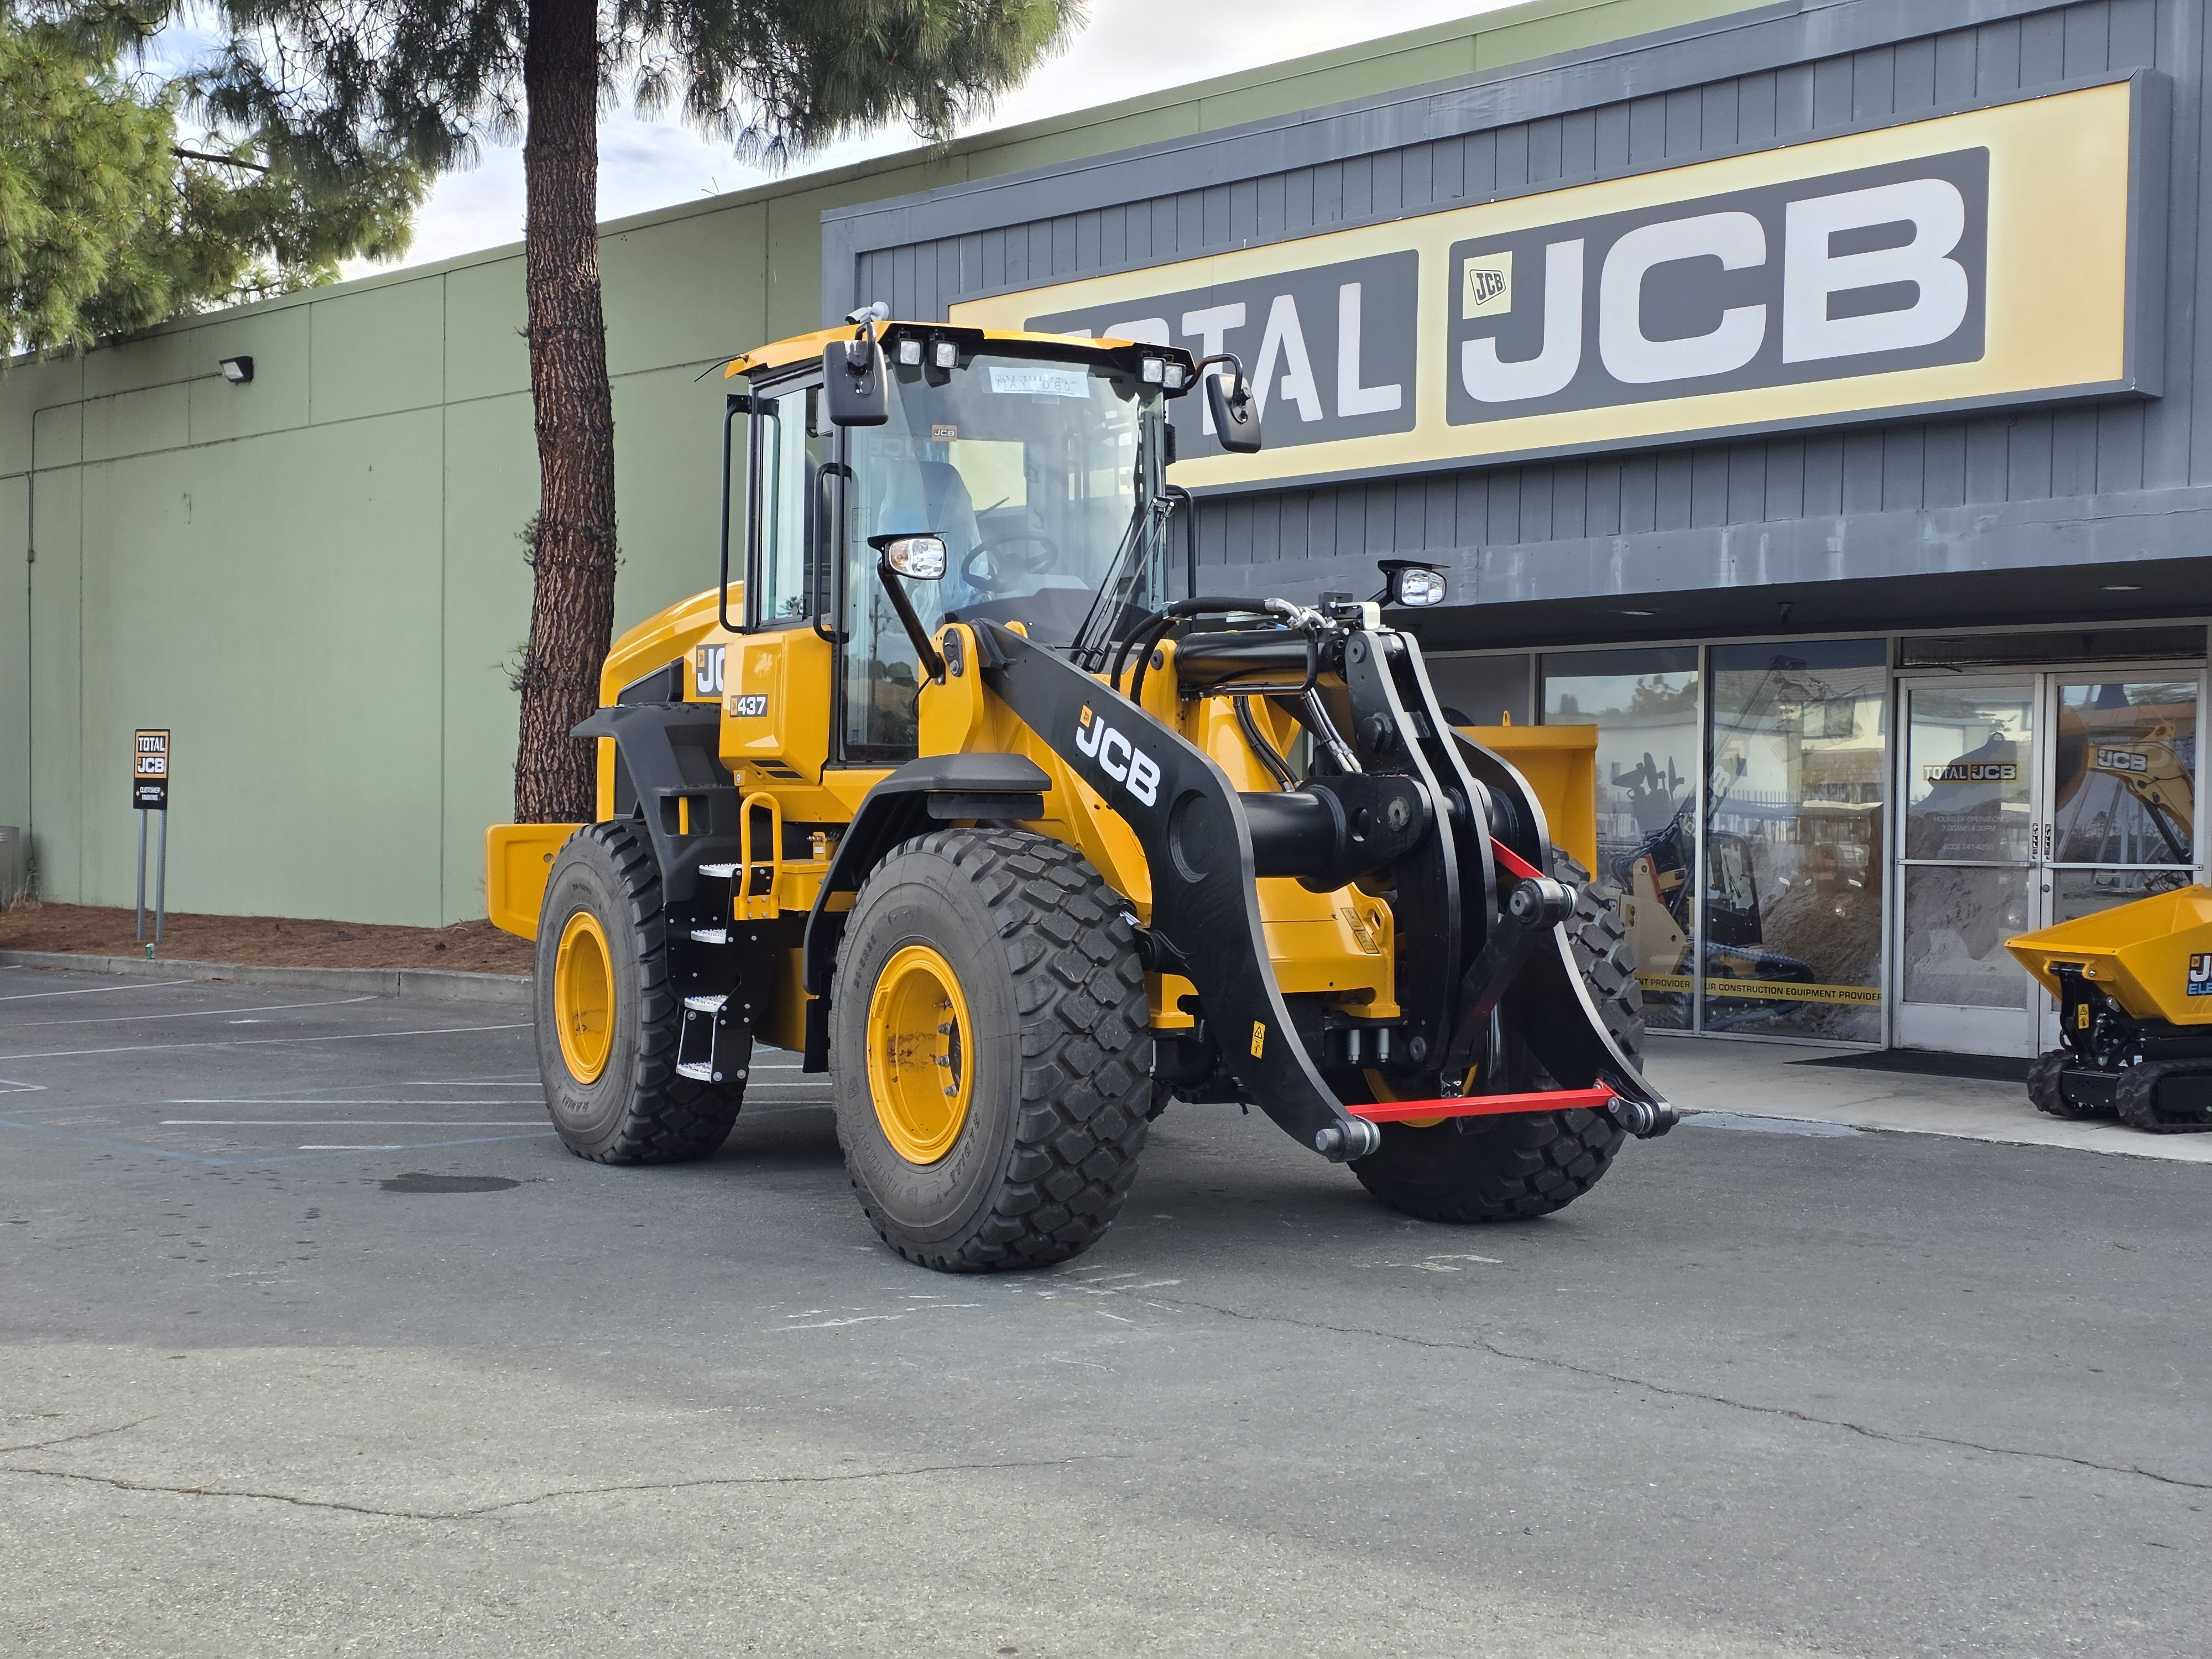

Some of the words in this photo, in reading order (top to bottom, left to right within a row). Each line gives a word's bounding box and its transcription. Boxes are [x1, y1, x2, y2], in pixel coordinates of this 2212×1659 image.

[1476, 273, 1504, 301] JCB
[1058, 283, 1402, 436] TAL
[1462, 178, 1968, 403] JCB
[737, 696, 766, 715] 437
[138, 737, 165, 751] TOTAL
[137, 758, 164, 773] JCB
[1076, 716, 1161, 807] JCB
[2098, 750, 2147, 771] JCB
[1924, 766, 1966, 779] TOTAL
[1972, 765, 2016, 779] JCB
[1650, 979, 1691, 988] PROVIDER
[1718, 983, 1783, 995] CONSTRUCTION
[1786, 988, 1837, 998] EQUIPMENT
